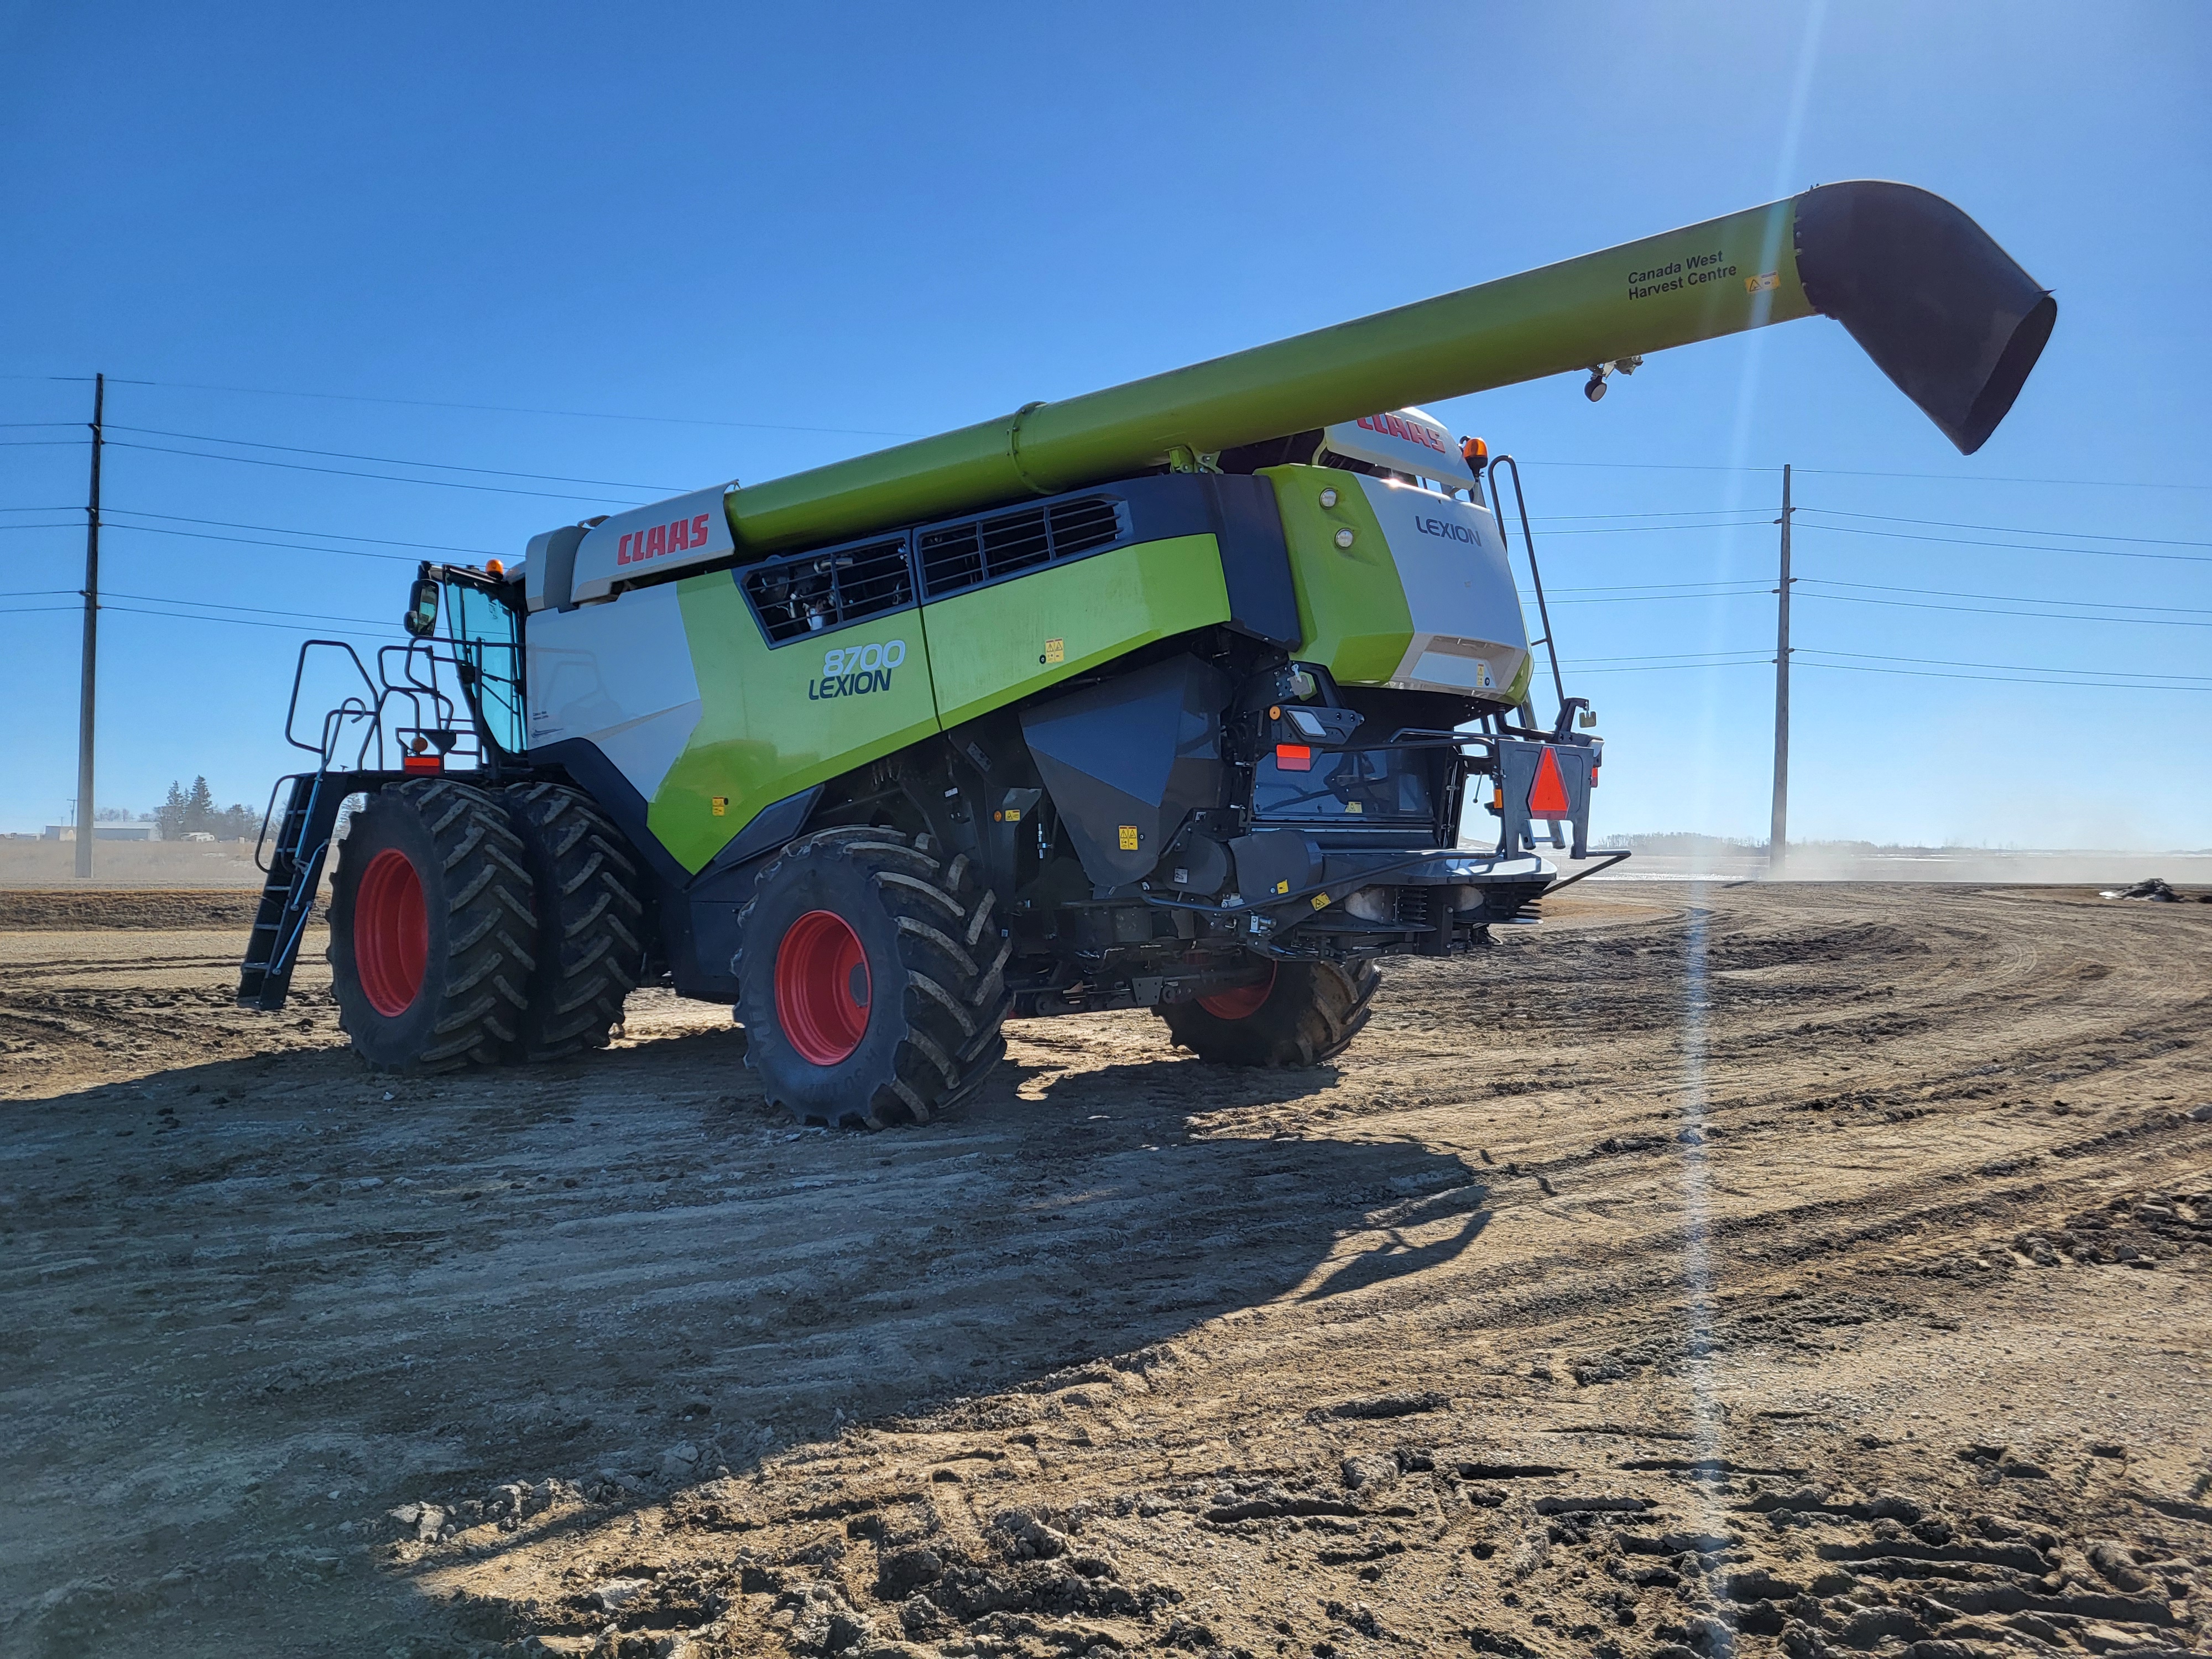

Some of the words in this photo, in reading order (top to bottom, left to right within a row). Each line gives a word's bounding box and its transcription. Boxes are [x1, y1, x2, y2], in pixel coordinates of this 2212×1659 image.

[1628, 262, 1682, 284] Canada
[1686, 250, 1723, 270] West
[1629, 276, 1684, 300] Harvest
[1688, 265, 1737, 286] Centre
[617, 513, 709, 566] CLAAS
[1415, 515, 1482, 547] LEXION
[823, 639, 906, 677] 8700
[808, 668, 892, 700] LEXION
